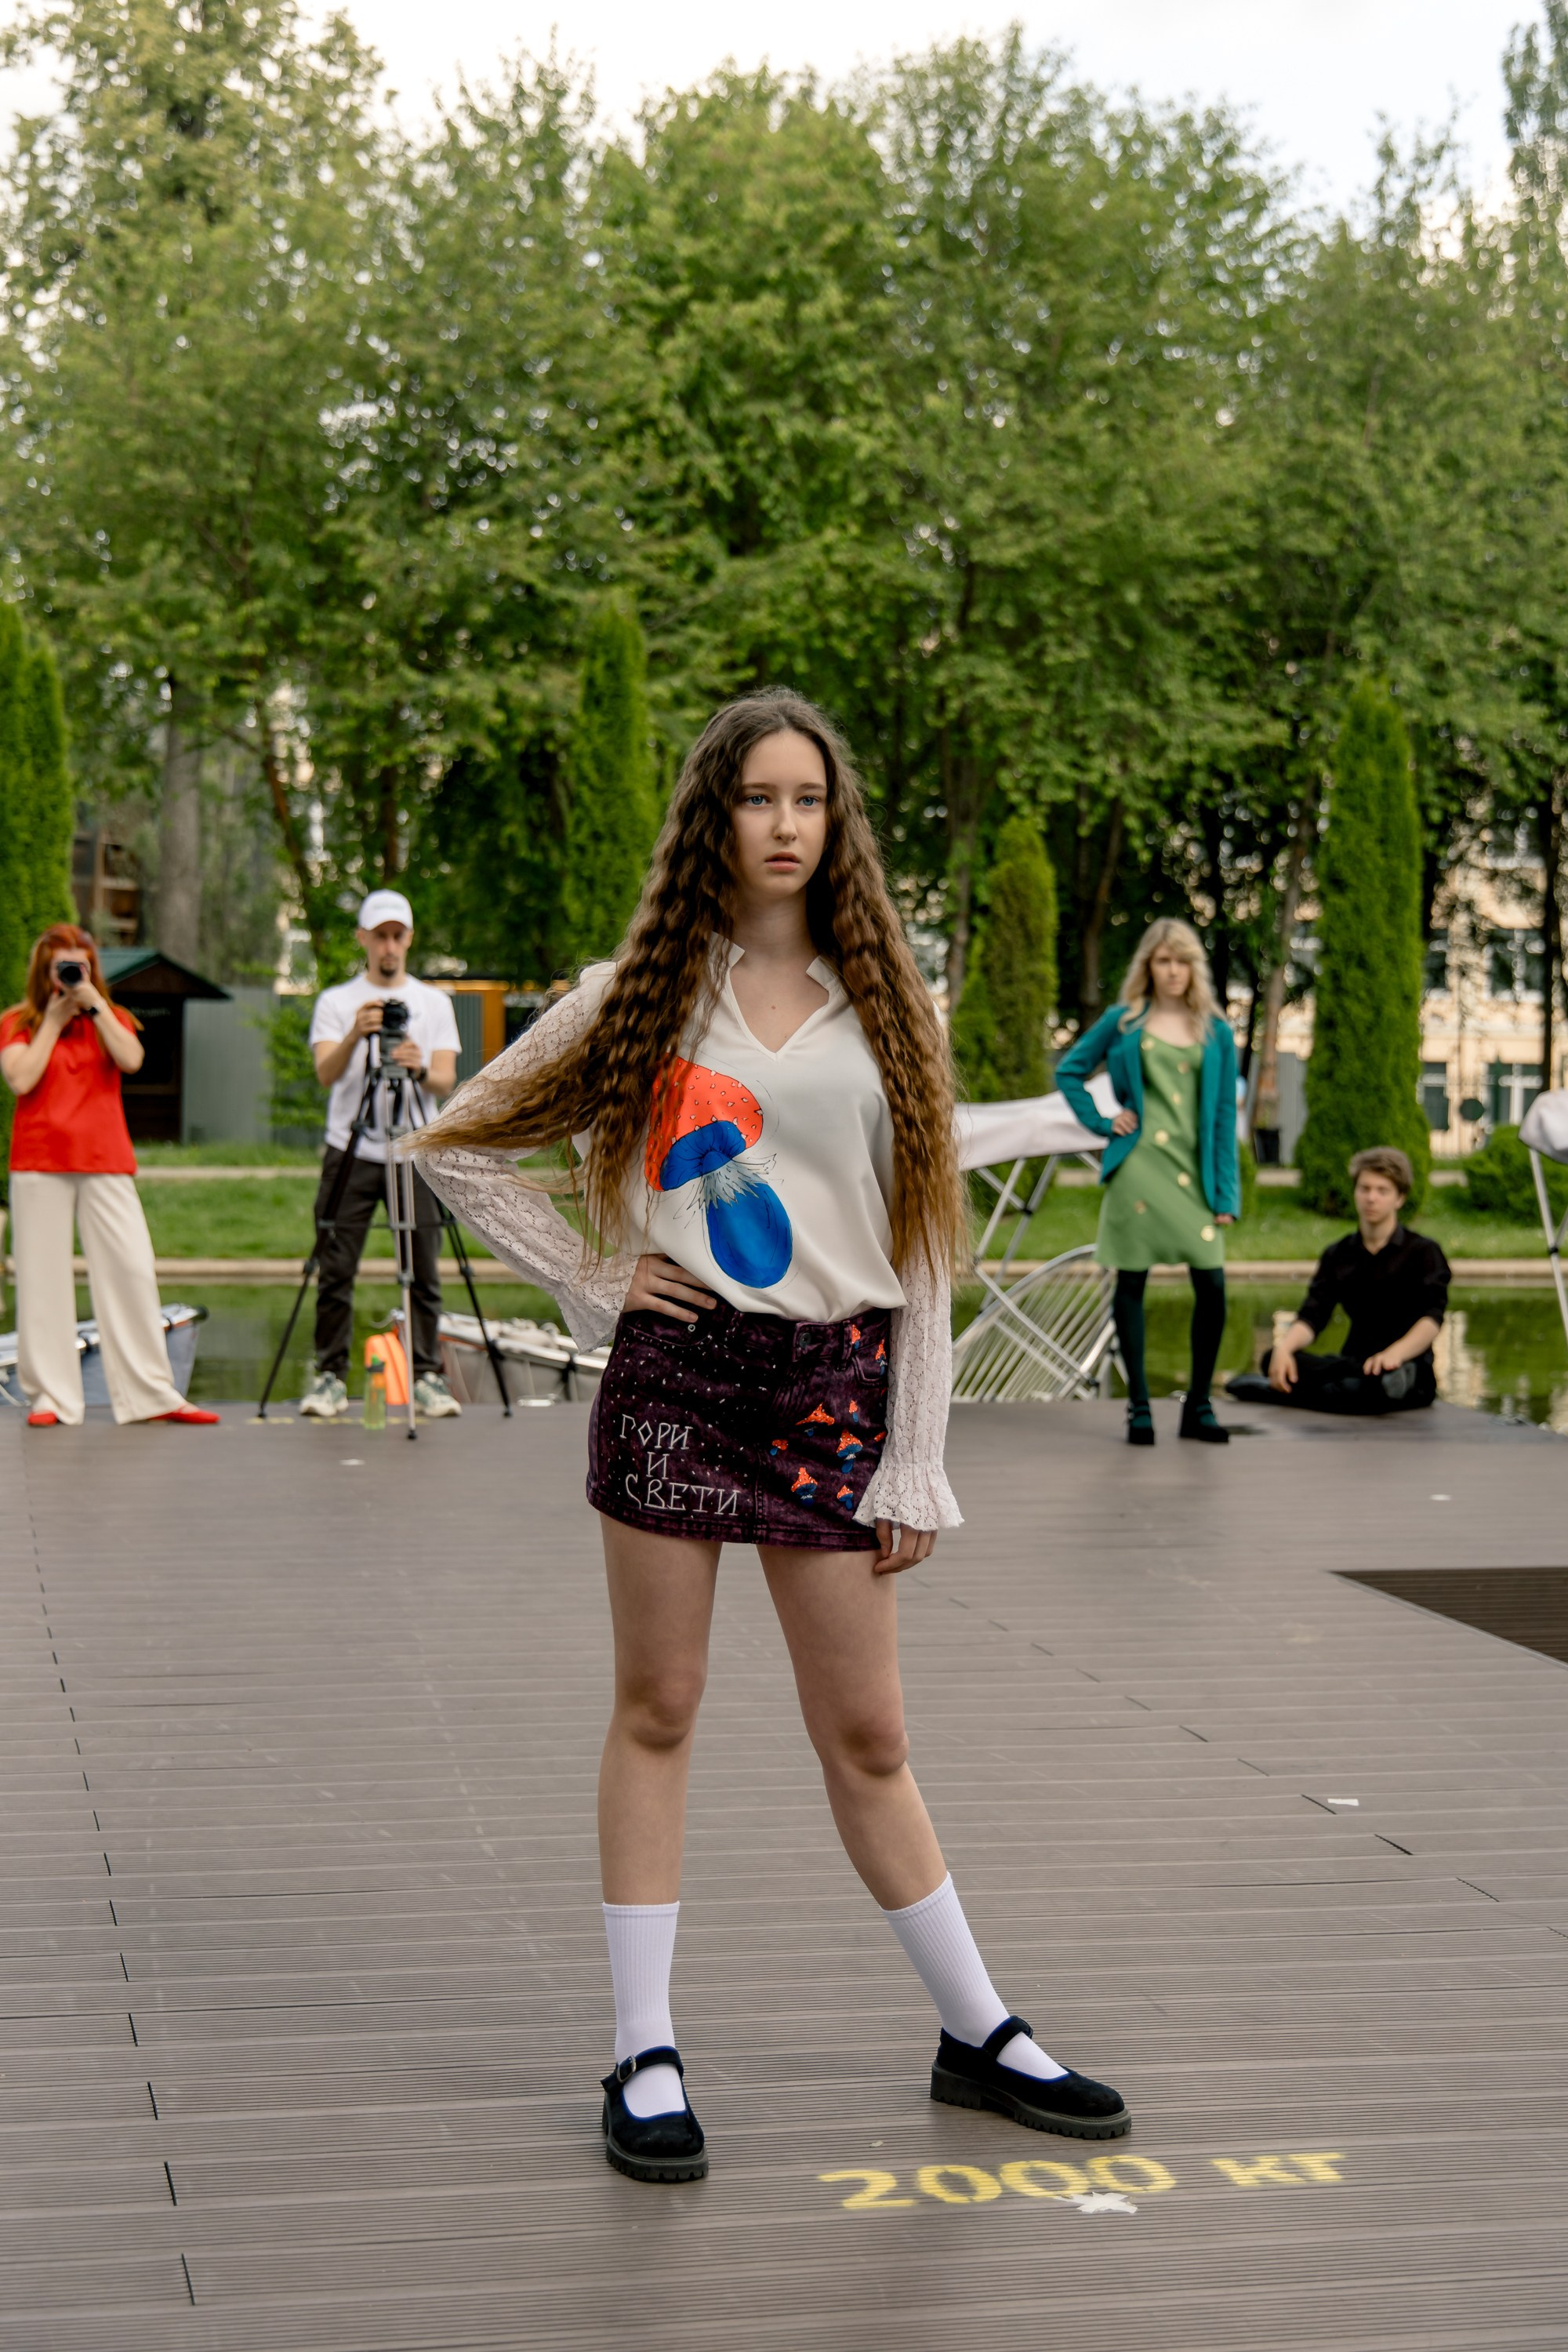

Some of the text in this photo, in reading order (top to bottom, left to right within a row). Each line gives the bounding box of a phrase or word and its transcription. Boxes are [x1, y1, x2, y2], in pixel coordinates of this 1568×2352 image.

[619, 1414, 693, 1450] ГОРИ
[646, 1451, 670, 1480] И
[625, 1473, 741, 1515] СВЕТИ
[816, 2154, 1175, 2209] 2000
